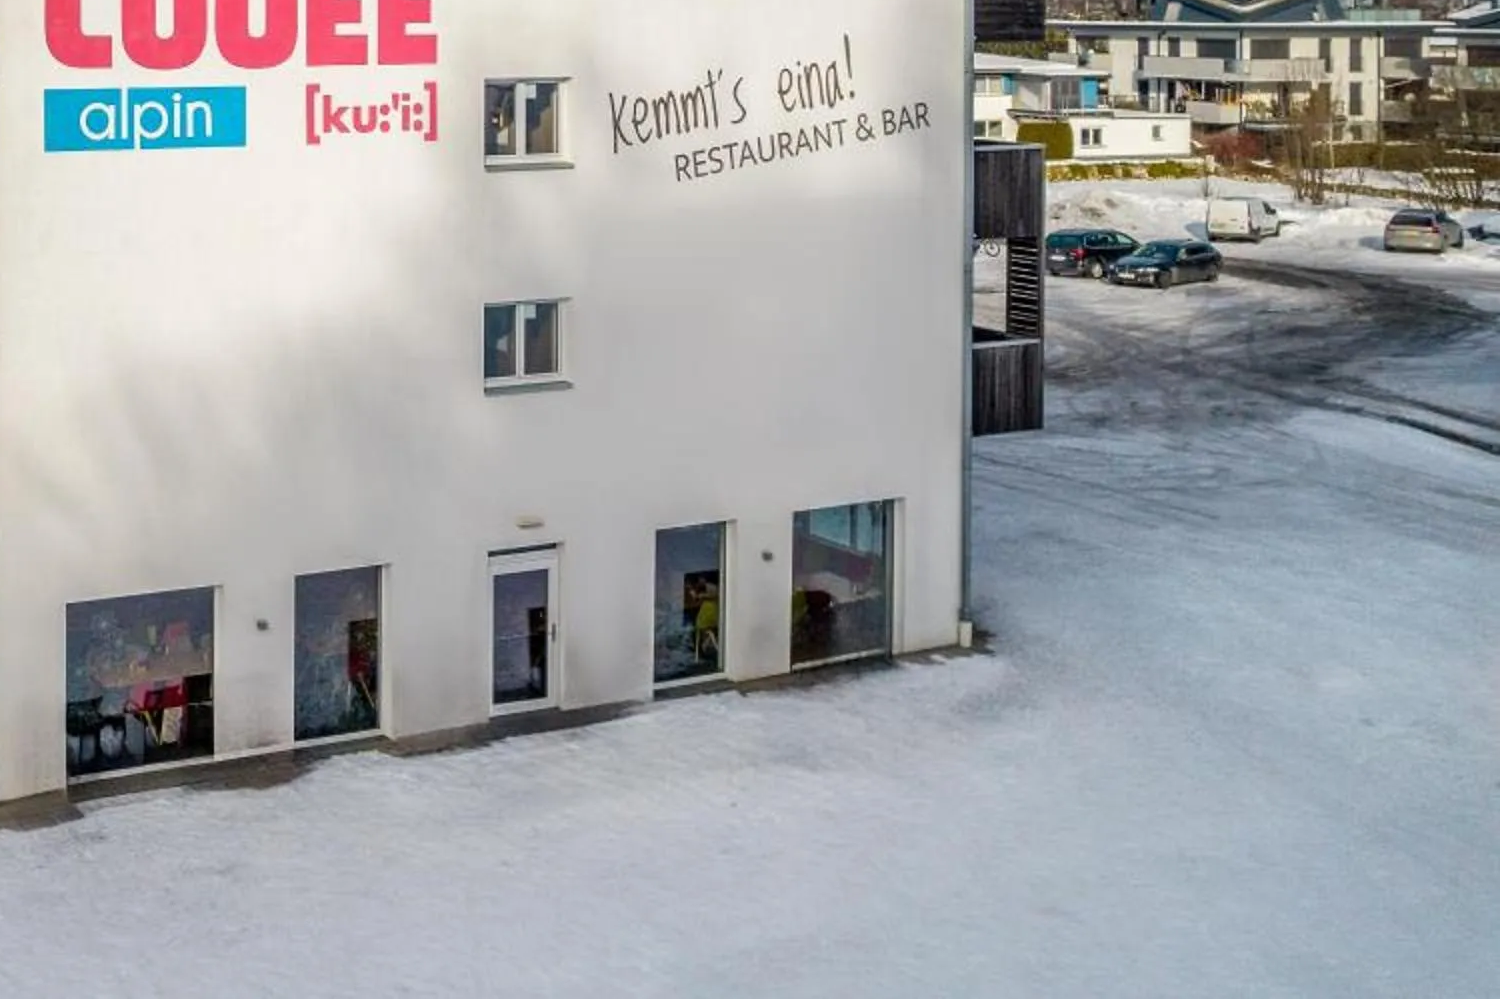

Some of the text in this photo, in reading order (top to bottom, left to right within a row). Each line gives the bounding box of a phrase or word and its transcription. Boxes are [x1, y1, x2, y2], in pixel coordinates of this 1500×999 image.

[777, 33, 855, 112] eina!
[79, 86, 213, 150] alpin
[674, 102, 930, 182] RESTAURANT & BAR
